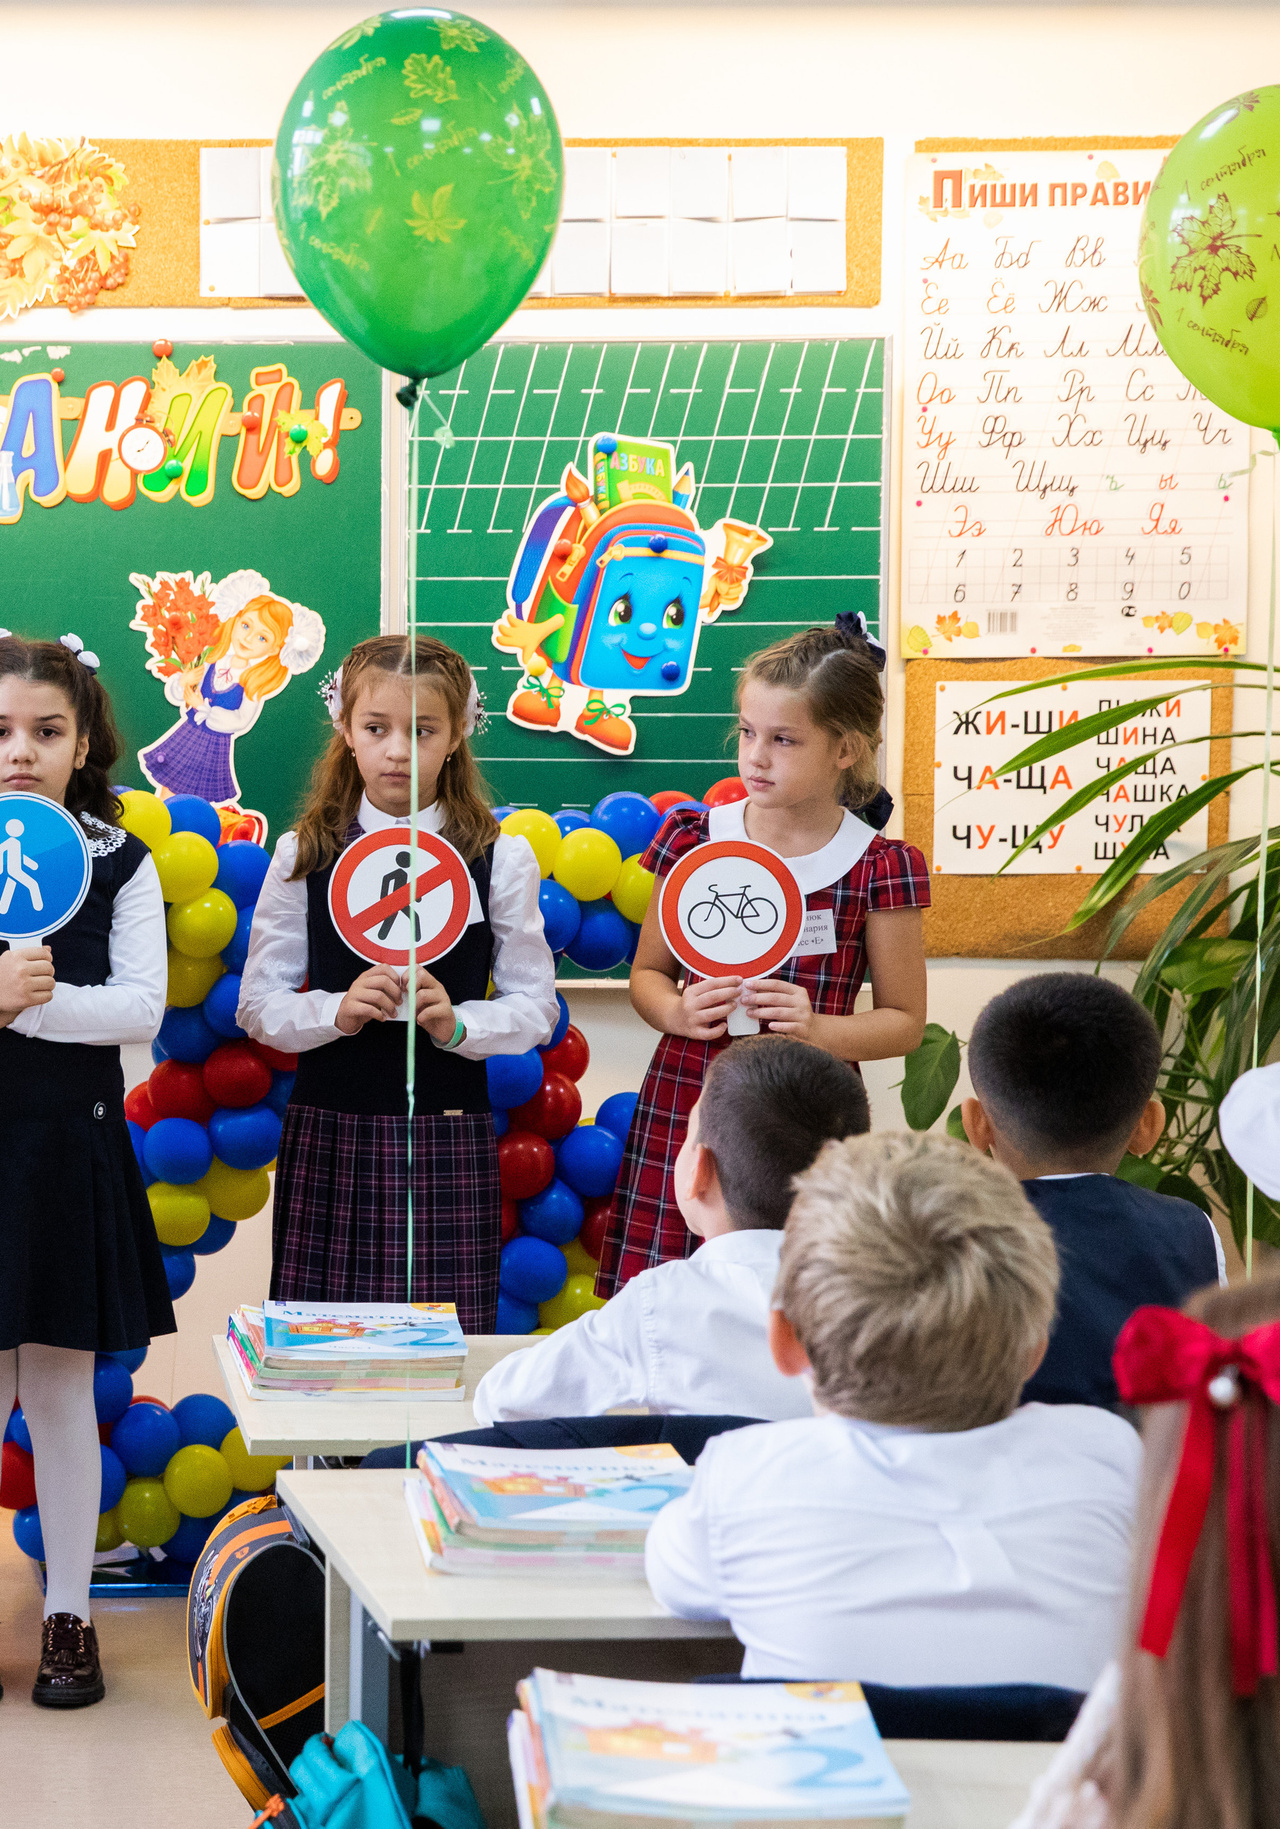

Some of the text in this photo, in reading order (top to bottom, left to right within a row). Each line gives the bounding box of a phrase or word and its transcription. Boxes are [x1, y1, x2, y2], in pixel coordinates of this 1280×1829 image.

[1048, 181, 1151, 206] ПРАВИ
[920, 235, 1106, 270] Аа Бб Вв
[920, 277, 1108, 315] Ее Ёё Жж
[920, 322, 1167, 360] Йй Кк Лл Мм
[916, 372, 956, 405] Оо
[977, 369, 1023, 403] Пп
[1057, 369, 1096, 414] Рр
[1125, 368, 1155, 401] Сс
[916, 412, 1232, 460] Уу Фф Хх Цц Чч
[610, 451, 665, 477] АЗБУКА
[916, 461, 980, 493] Шш
[1012, 460, 1079, 500] Щщ
[1158, 473, 1179, 490] ы
[948, 502, 1183, 538] Ээ Юю Яя
[956, 546, 1192, 568] 1 2 3 4 5
[953, 581, 1191, 603] 6 7 8 9 0
[1098, 699, 1181, 717] ЛЖИ
[1097, 726, 1177, 745] ШИНА
[953, 765, 1073, 795] ЧА-ЩА
[392, 1328, 459, 1346] 2
[767, 1744, 885, 1789] 2
